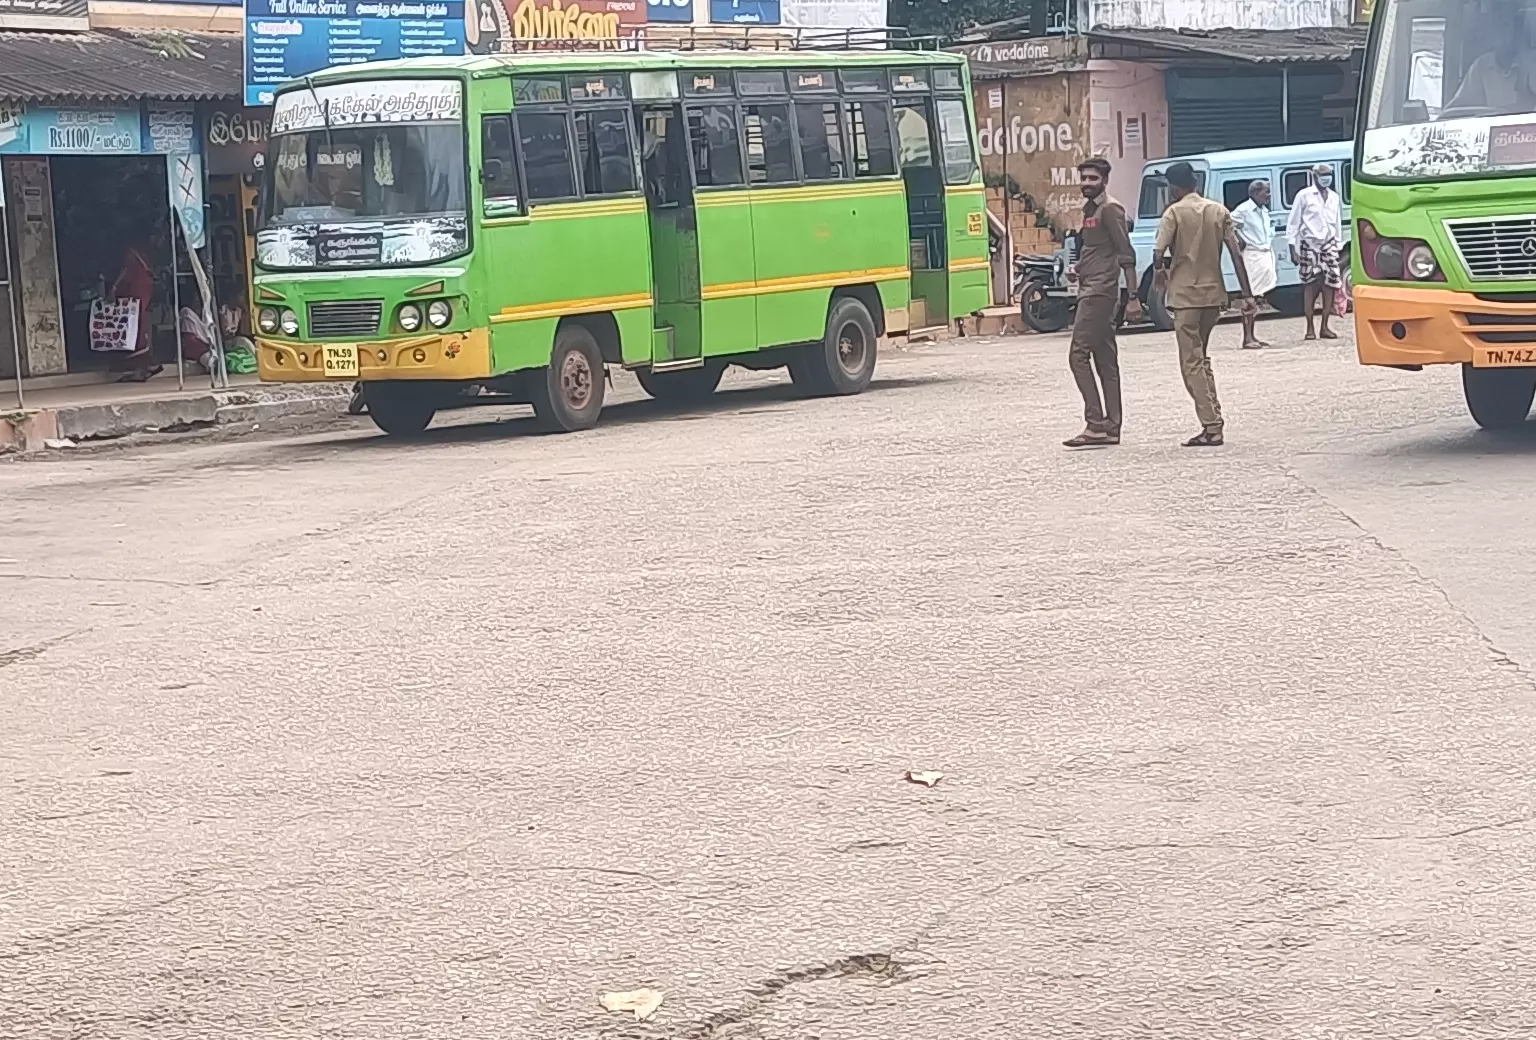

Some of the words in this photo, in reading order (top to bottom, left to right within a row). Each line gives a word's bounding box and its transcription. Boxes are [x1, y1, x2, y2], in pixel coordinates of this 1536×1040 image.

[994, 43, 1049, 62] vodafone
[326, 348, 352, 358] TN.59
[326, 359, 356, 370] Q.1271
